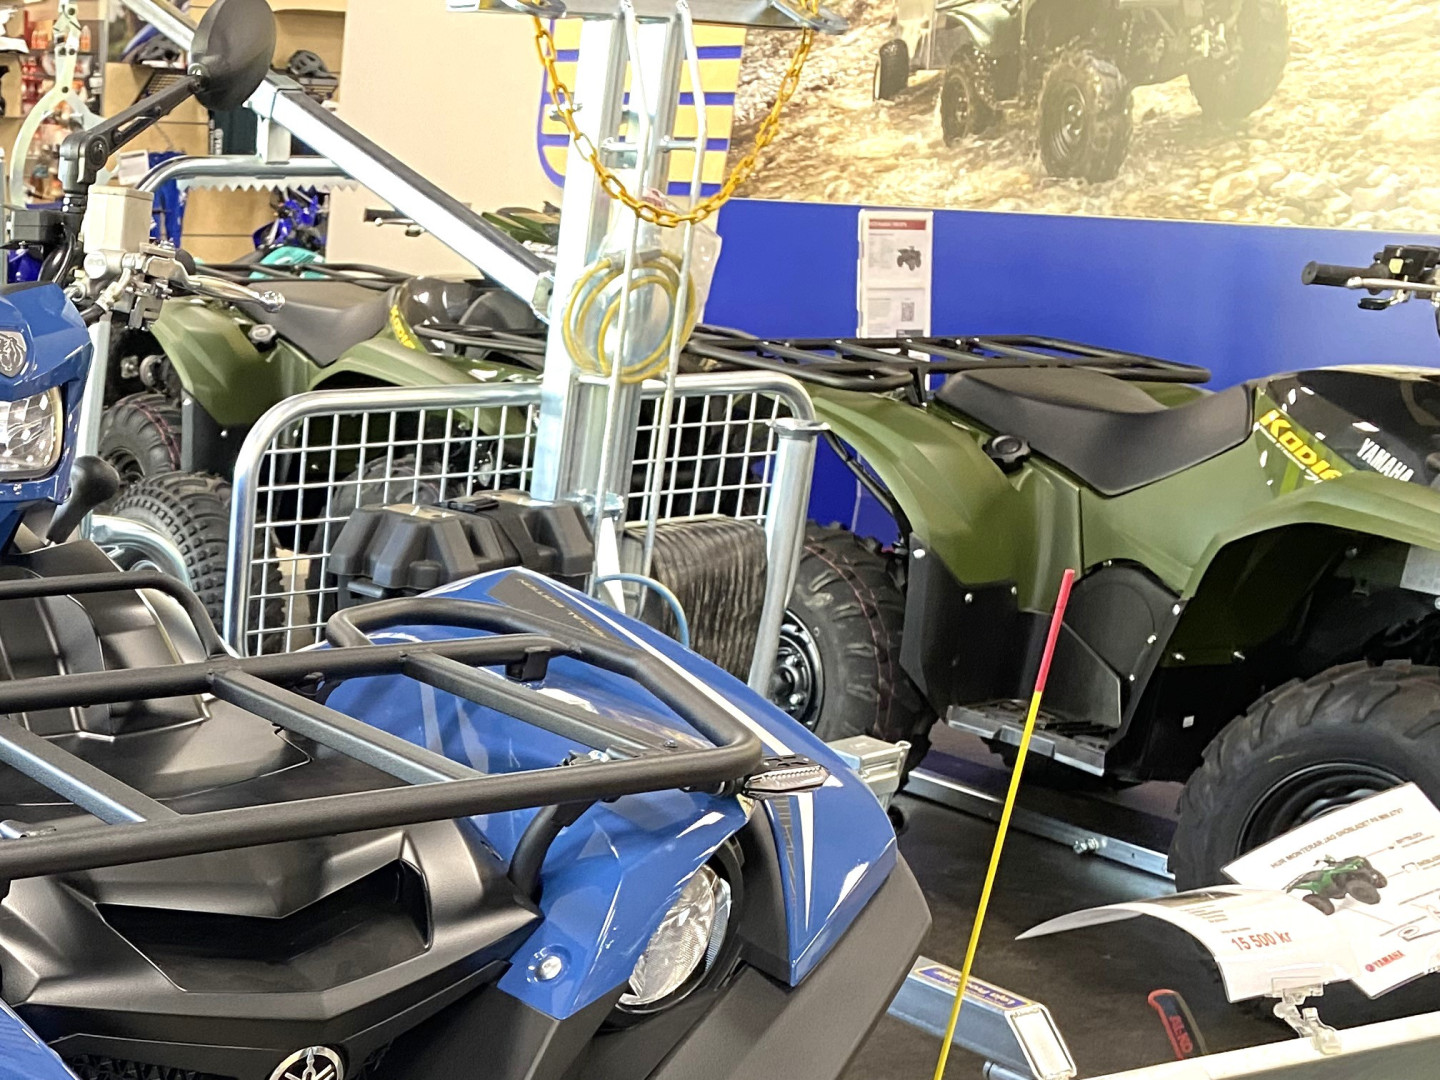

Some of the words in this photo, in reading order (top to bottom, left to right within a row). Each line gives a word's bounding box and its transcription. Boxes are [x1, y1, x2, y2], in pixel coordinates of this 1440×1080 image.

[1356, 437, 1415, 482] YAMAHA
[1231, 936, 1251, 950] 15
[1250, 932, 1277, 947] 500
[1274, 930, 1292, 943] kr
[1372, 950, 1405, 968] YAMAHA
